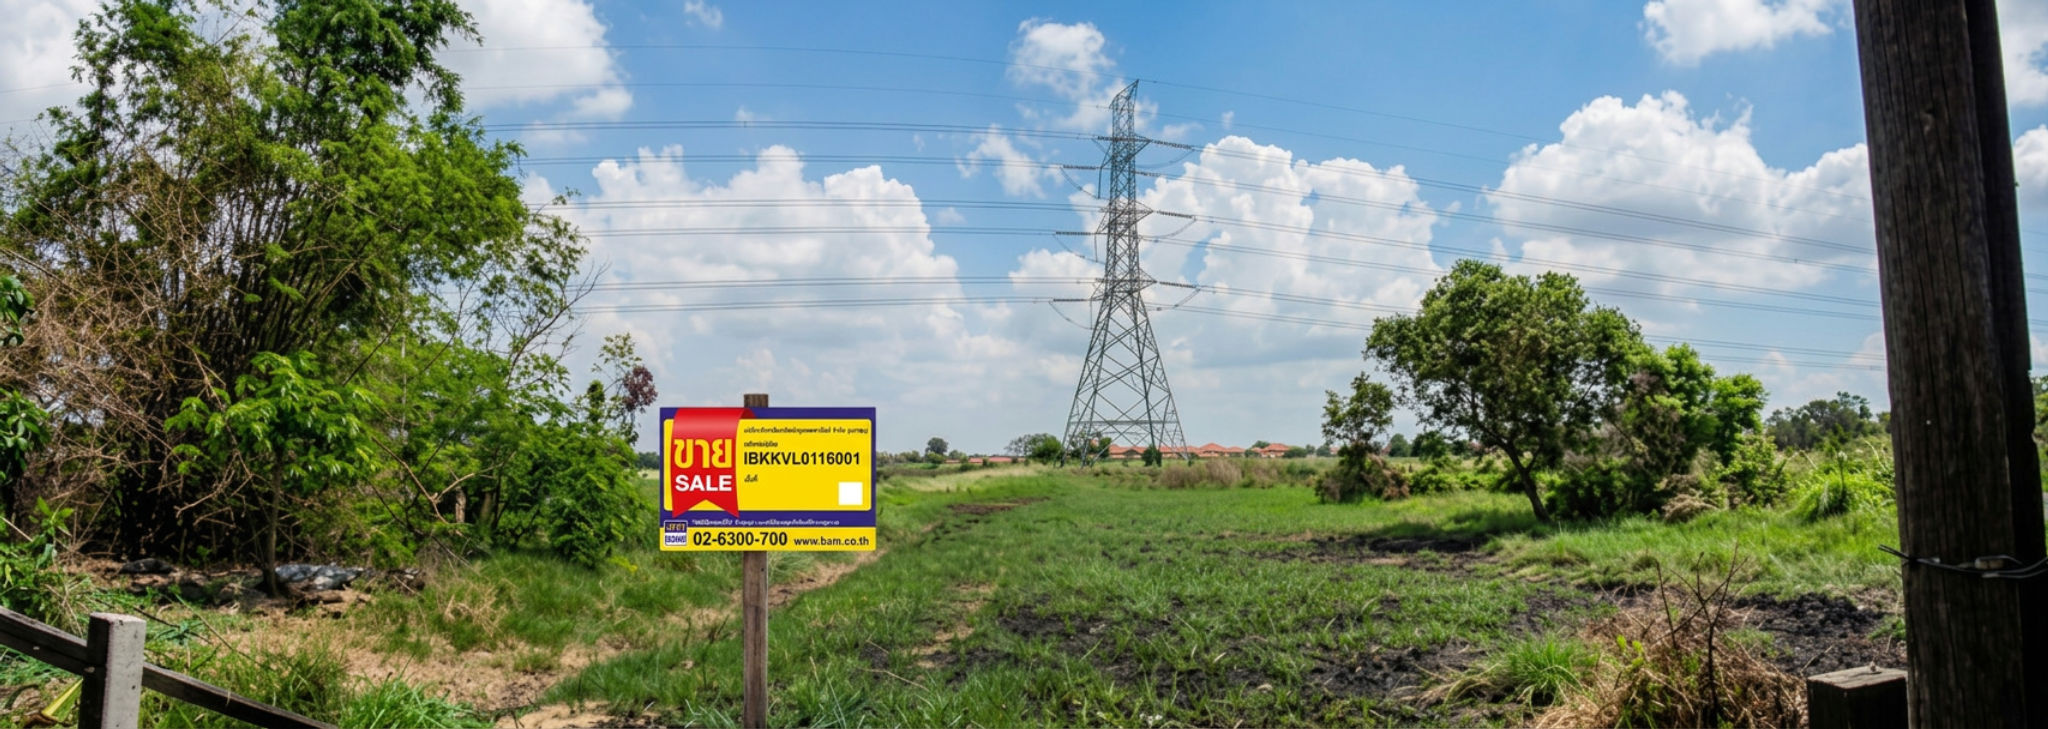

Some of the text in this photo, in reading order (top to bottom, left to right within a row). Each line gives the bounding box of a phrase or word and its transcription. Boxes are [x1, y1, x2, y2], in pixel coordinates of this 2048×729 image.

[673, 438, 733, 469] ขาย
[743, 451, 860, 465] IBKKVL0116001
[675, 474, 733, 492] SALE
[693, 531, 788, 546] 02-6300-700
[793, 535, 870, 546] www.bam.co.th
